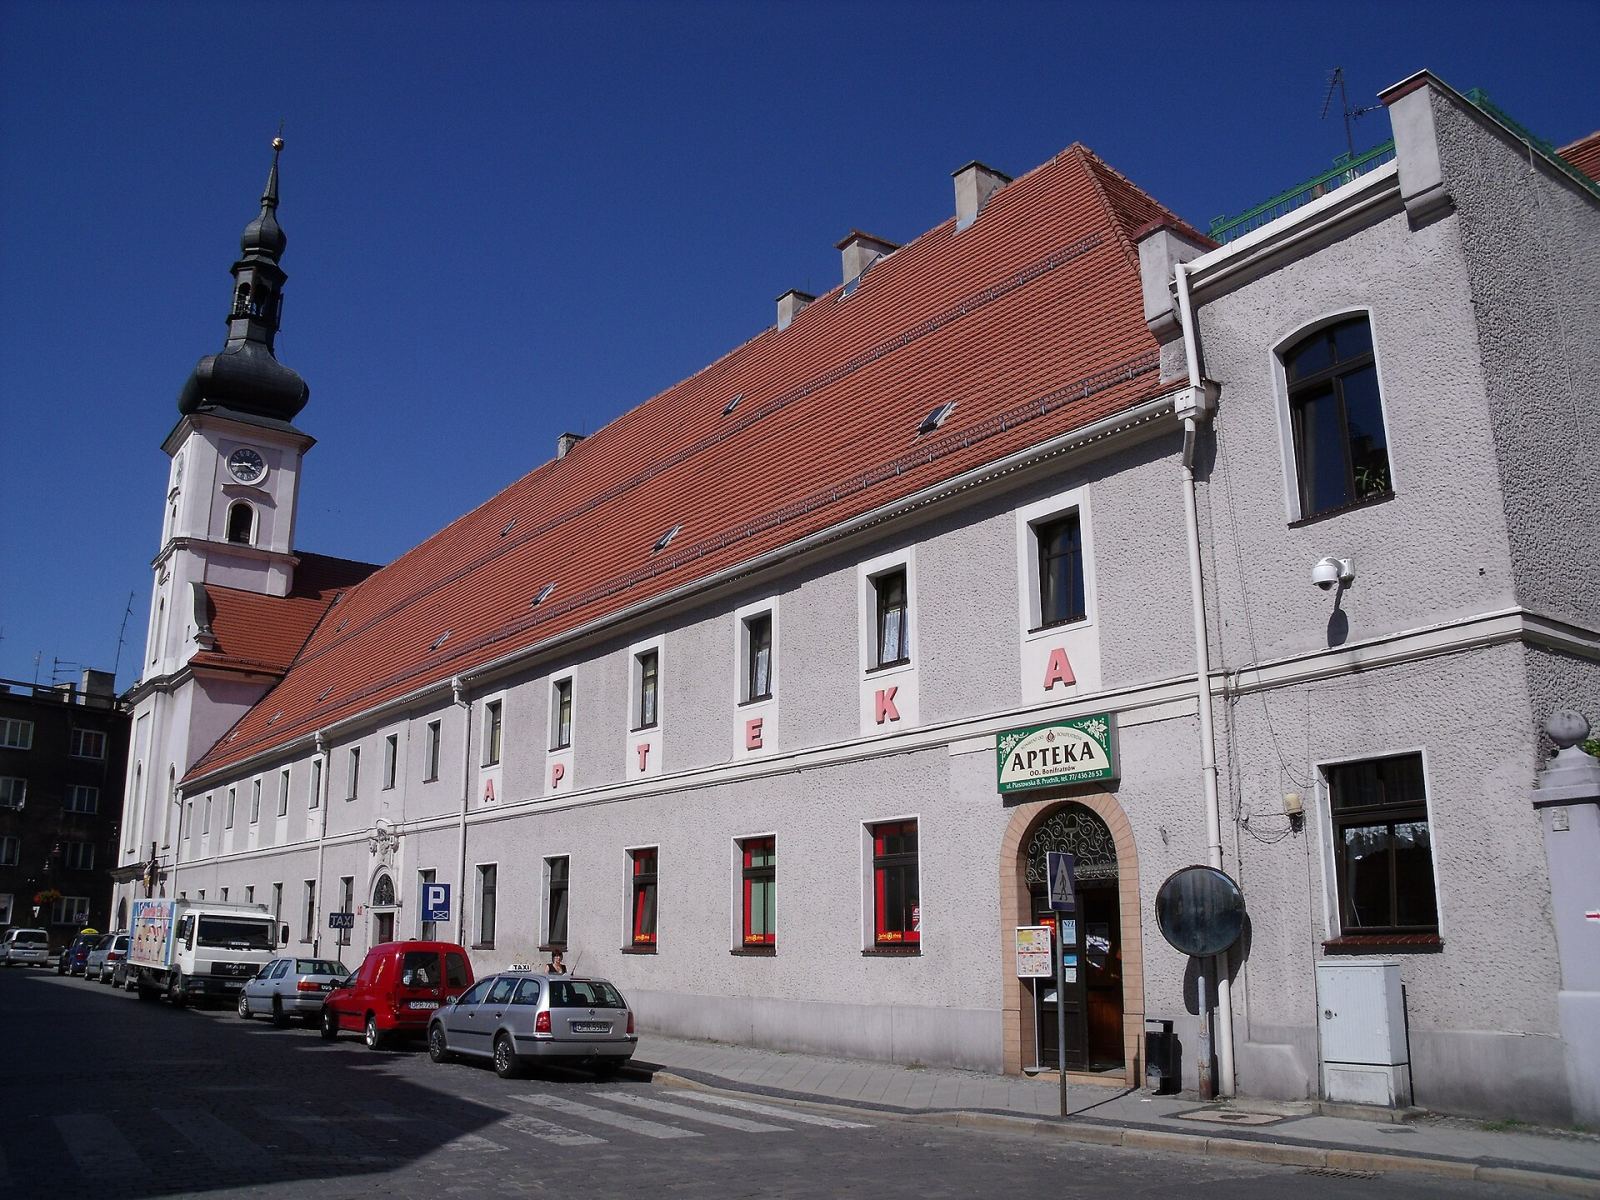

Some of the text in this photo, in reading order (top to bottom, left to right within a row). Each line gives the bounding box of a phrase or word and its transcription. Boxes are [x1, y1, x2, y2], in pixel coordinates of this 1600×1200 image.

[1011, 741, 1095, 772] APTEKA
[1042, 765, 1076, 775] Bonifratrów
[428, 887, 445, 911] P
[331, 915, 353, 928] TAXI
